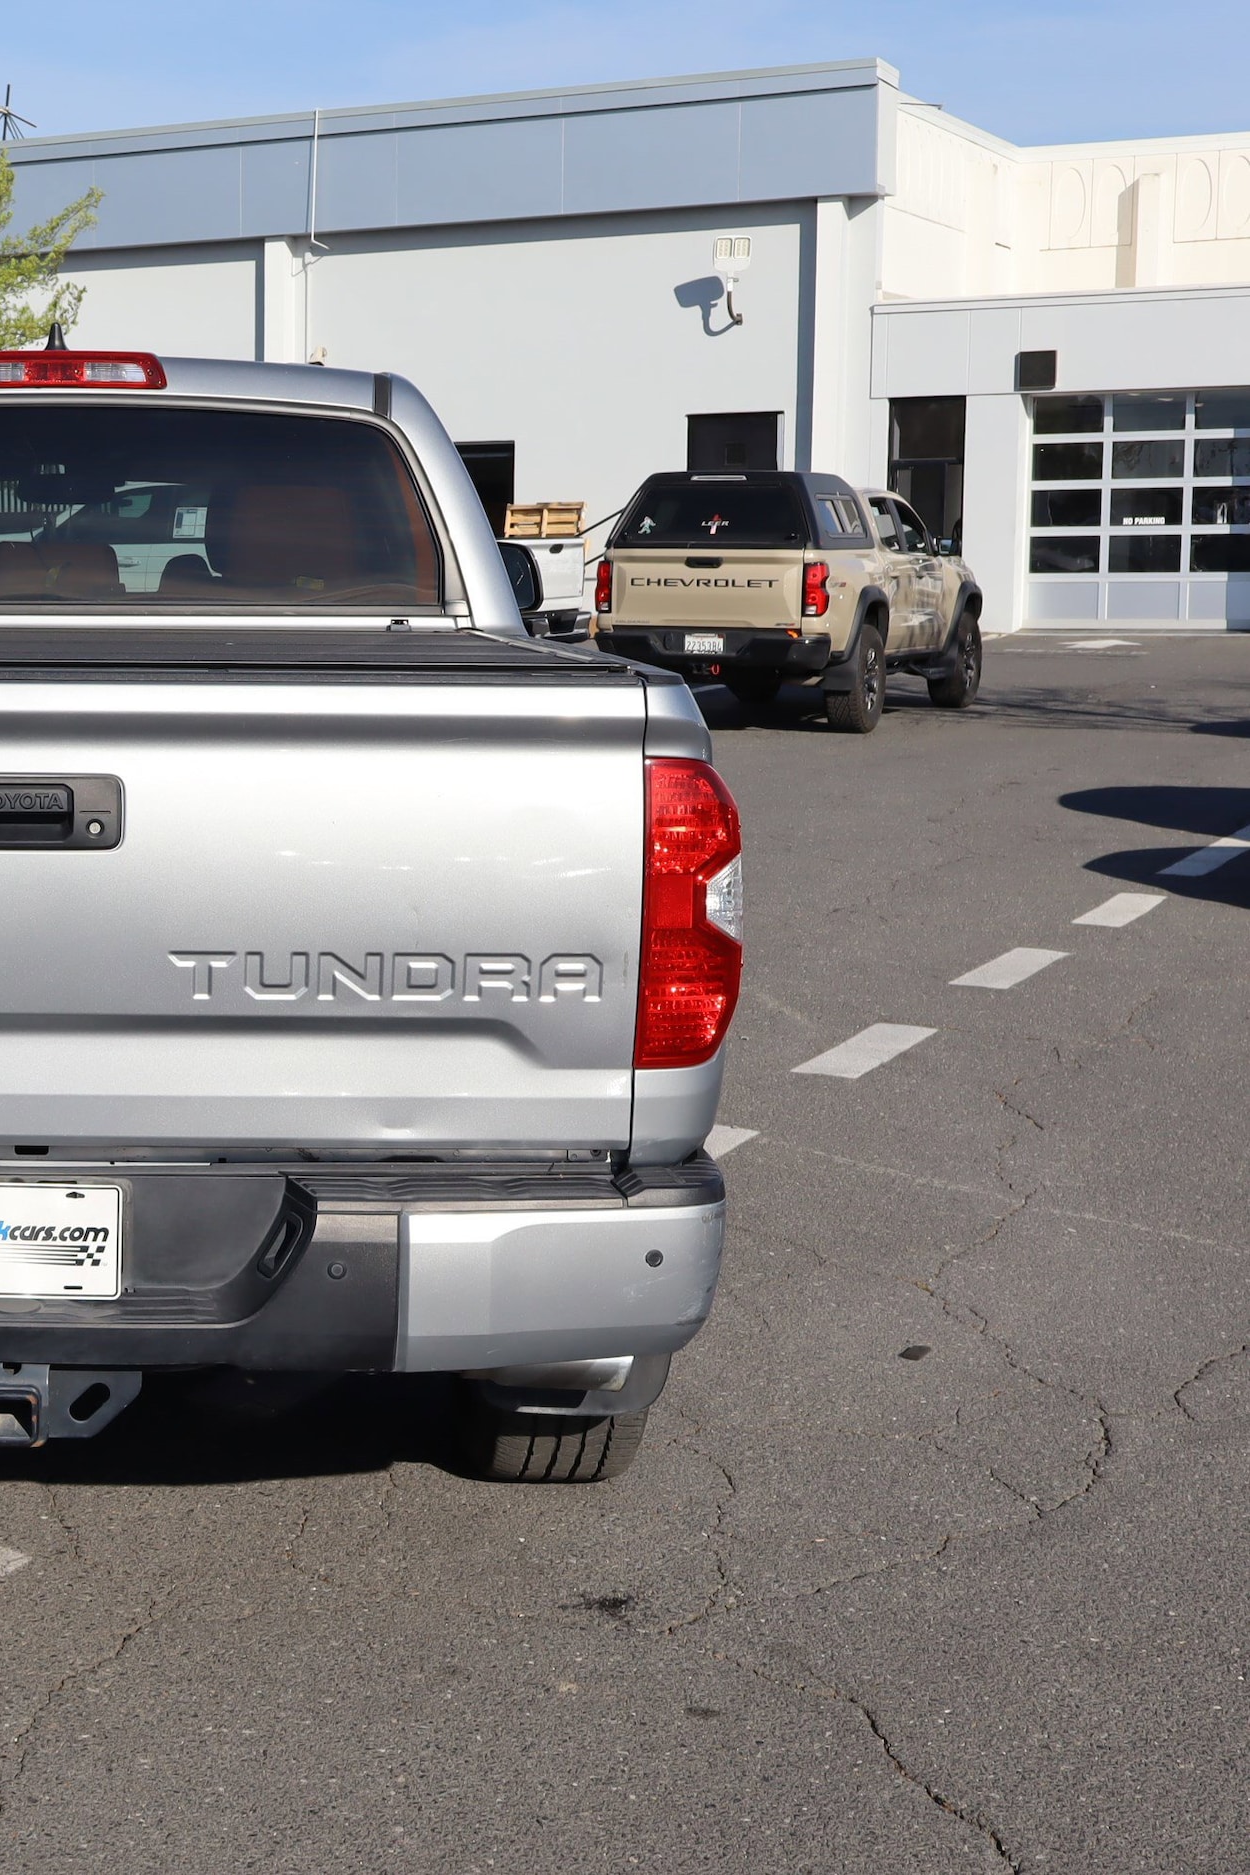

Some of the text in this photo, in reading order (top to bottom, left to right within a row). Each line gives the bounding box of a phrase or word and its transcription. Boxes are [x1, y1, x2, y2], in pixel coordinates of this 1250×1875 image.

[1123, 516, 1166, 526] NO PARKING
[630, 577, 780, 589] CHEVROLET
[168, 950, 604, 1002] TUNDRA
